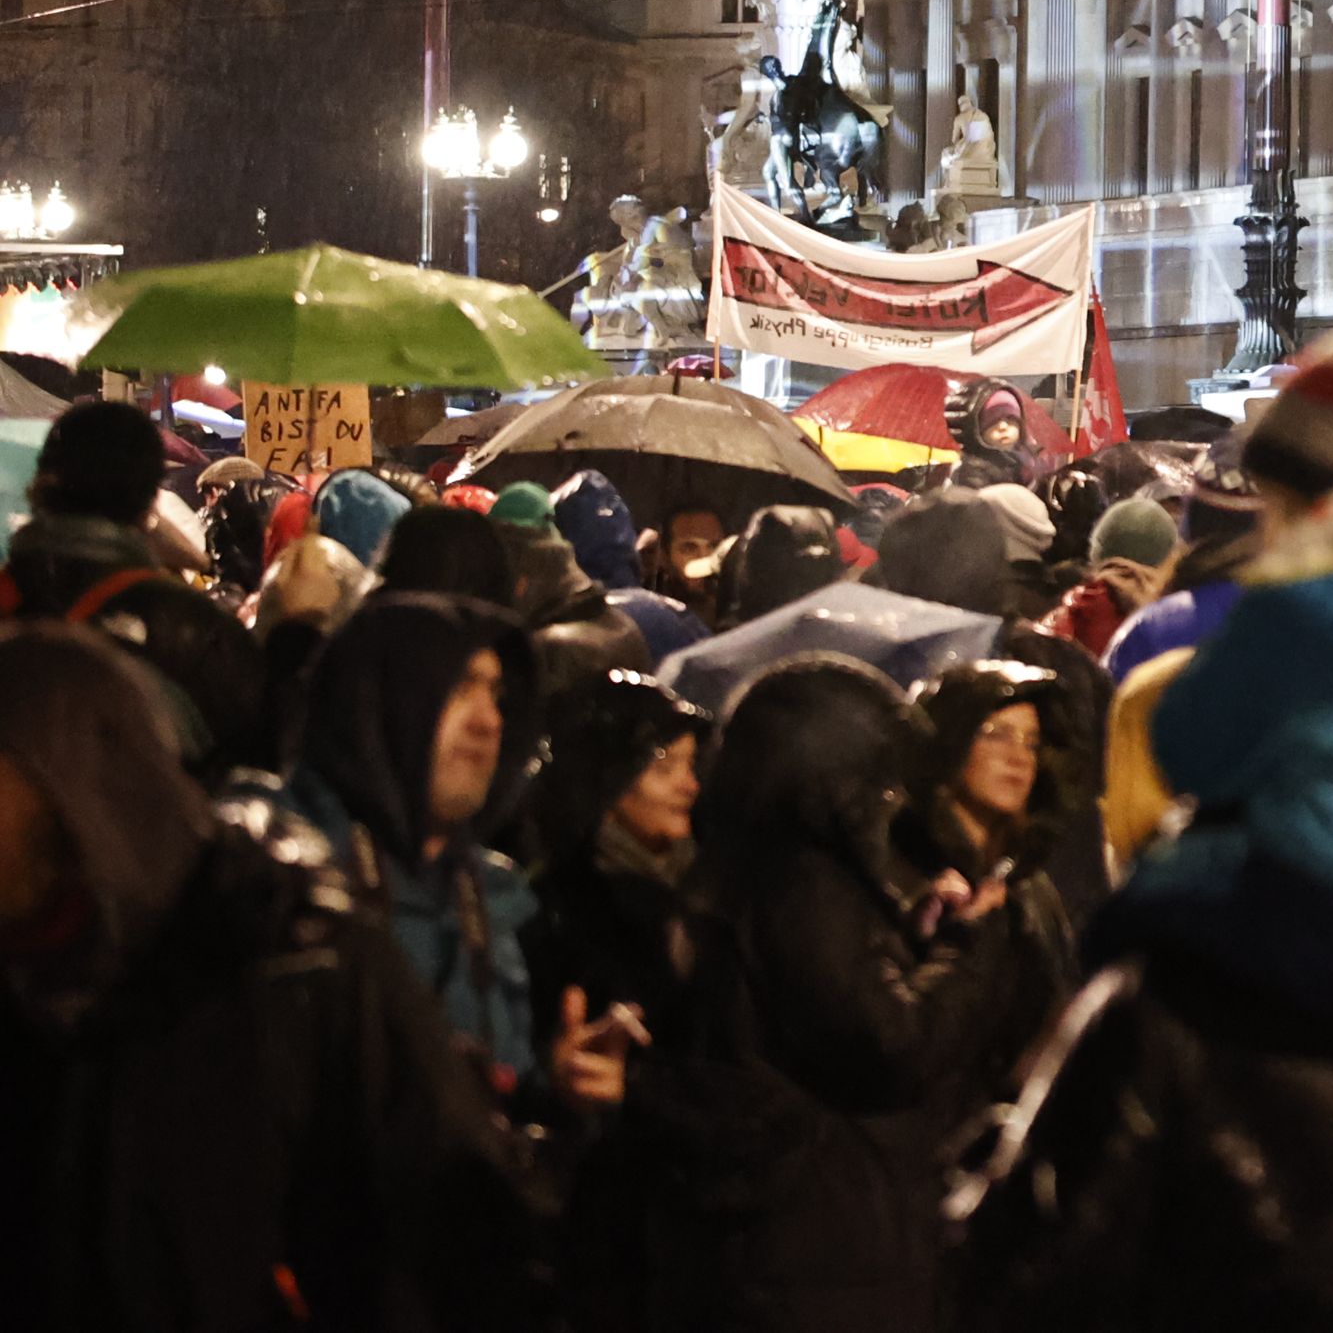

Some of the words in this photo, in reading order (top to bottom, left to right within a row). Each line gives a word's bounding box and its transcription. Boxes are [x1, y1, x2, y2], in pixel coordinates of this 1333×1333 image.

[254, 389, 342, 417] ANTIFA
[260, 419, 317, 443] BIST
[336, 419, 364, 442] DU
